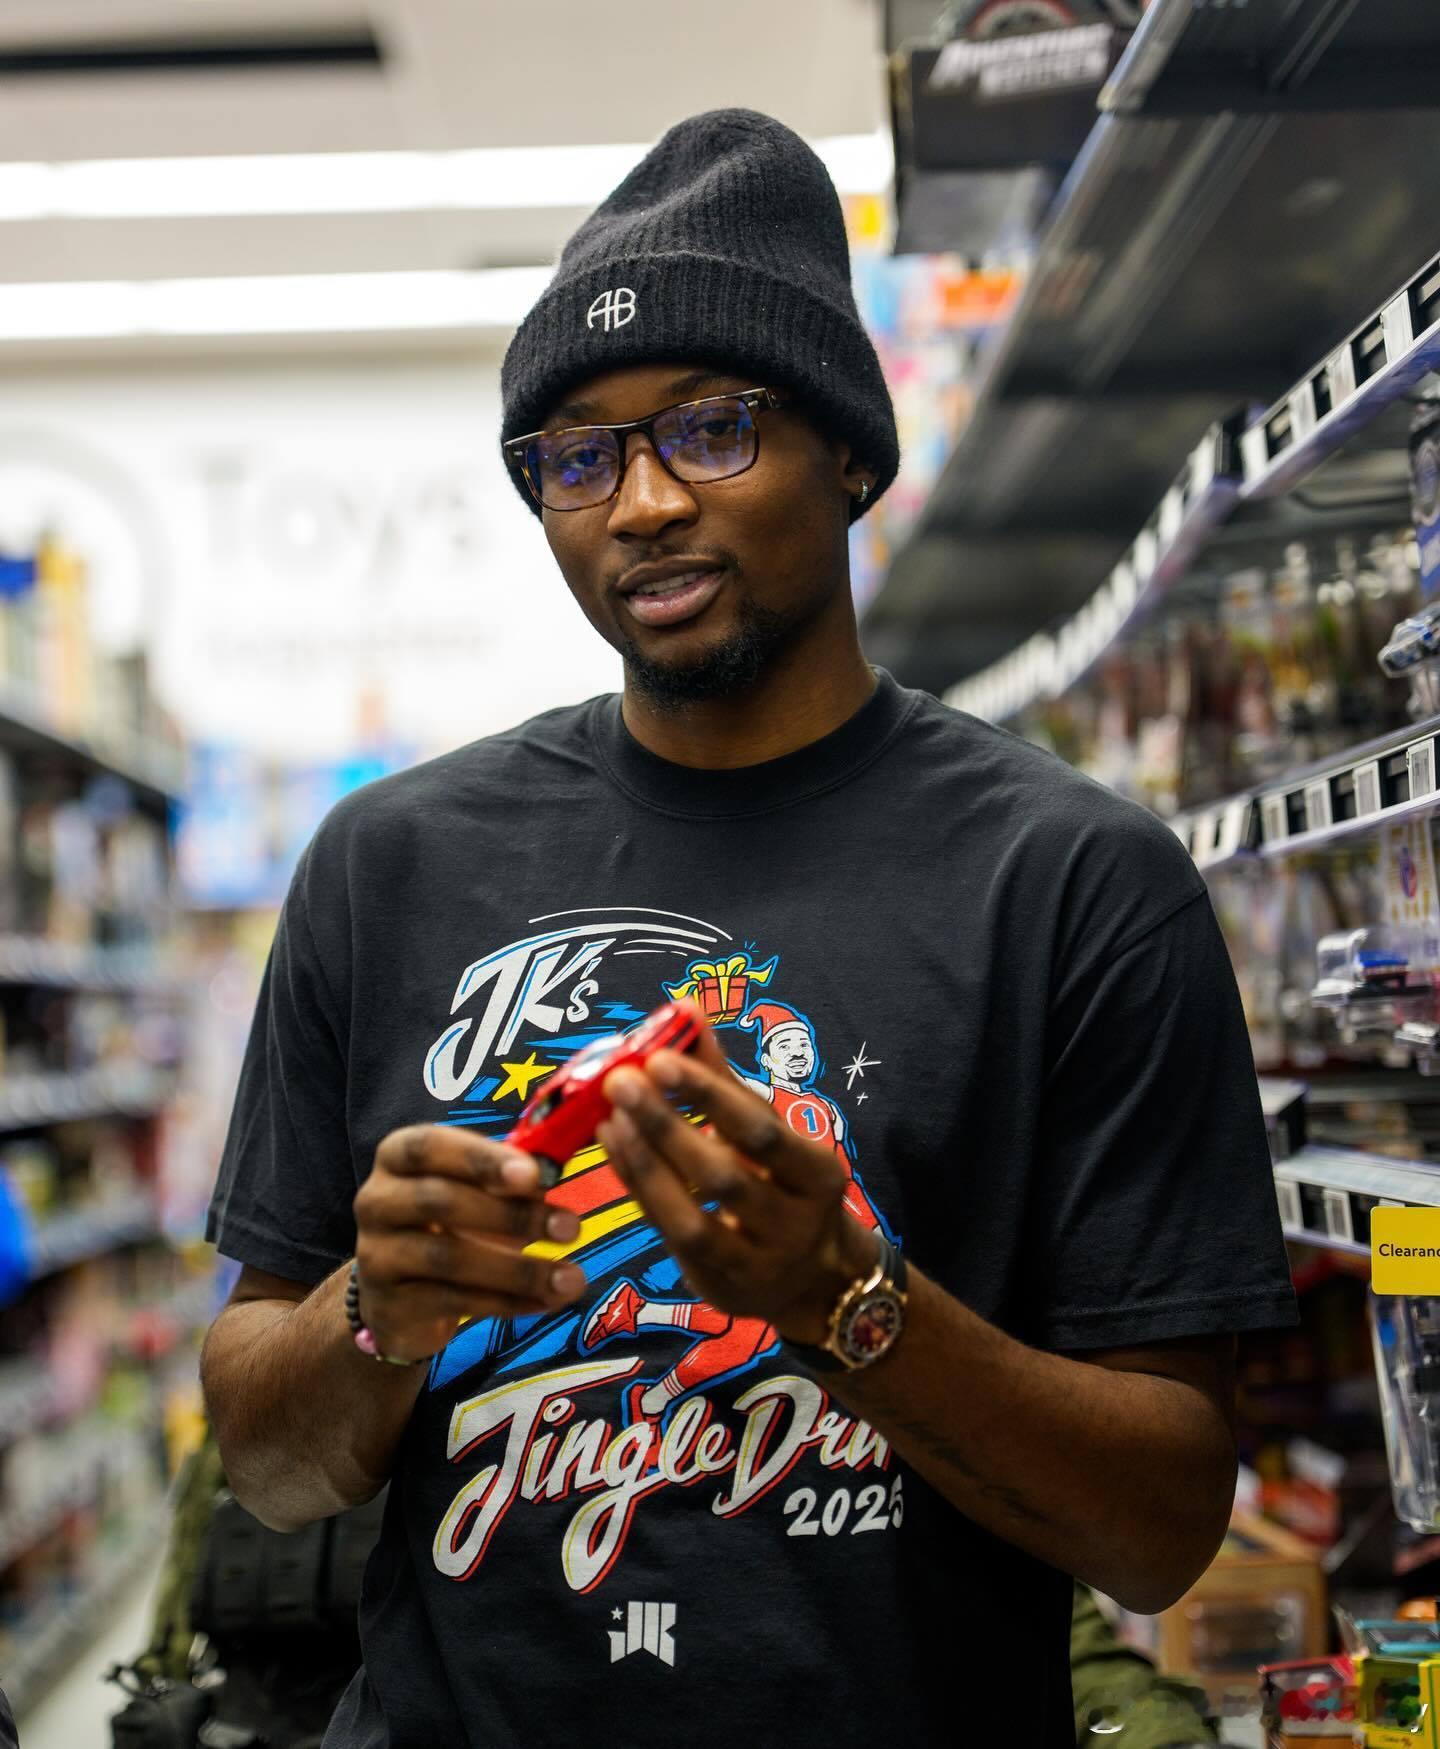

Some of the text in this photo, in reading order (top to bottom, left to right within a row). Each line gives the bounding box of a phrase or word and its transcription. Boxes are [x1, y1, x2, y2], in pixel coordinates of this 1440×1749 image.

[587, 287, 637, 332] AB
[801, 1106, 819, 1133] 1
[432, 1356, 736, 1595] Jingle
